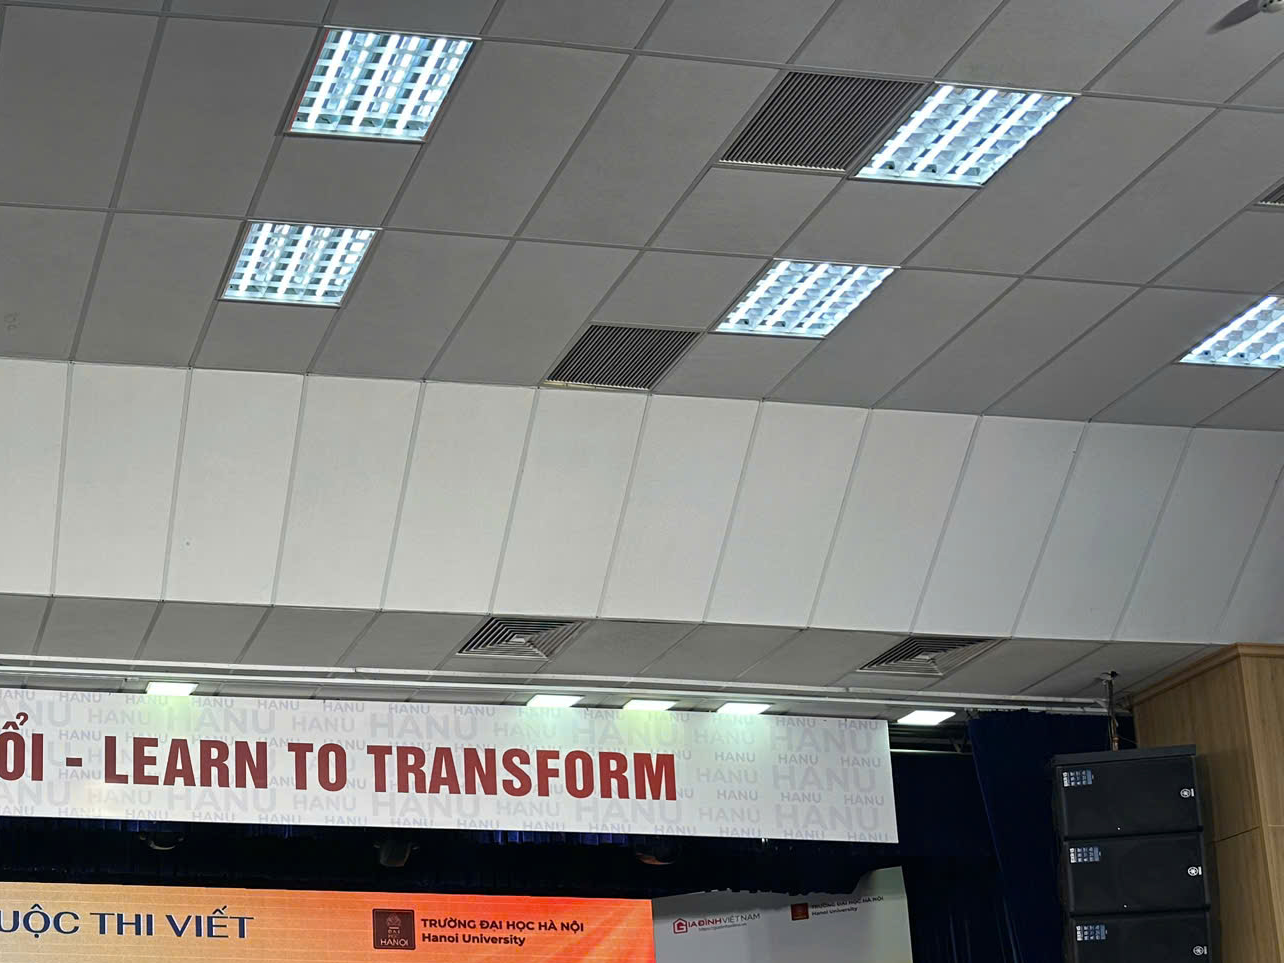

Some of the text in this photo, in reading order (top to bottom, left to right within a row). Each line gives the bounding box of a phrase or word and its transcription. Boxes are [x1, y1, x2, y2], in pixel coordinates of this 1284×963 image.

[104, 735, 269, 789] LEARN
[287, 742, 348, 792] TO
[366, 744, 677, 801] TRANSFORM
[90, 911, 156, 937] THI
[166, 905, 255, 939] VIẾT
[421, 917, 584, 934] TRƯỜNG ĐẠI HỌC HÀ NỘI
[421, 932, 526, 947] Hanoi University
